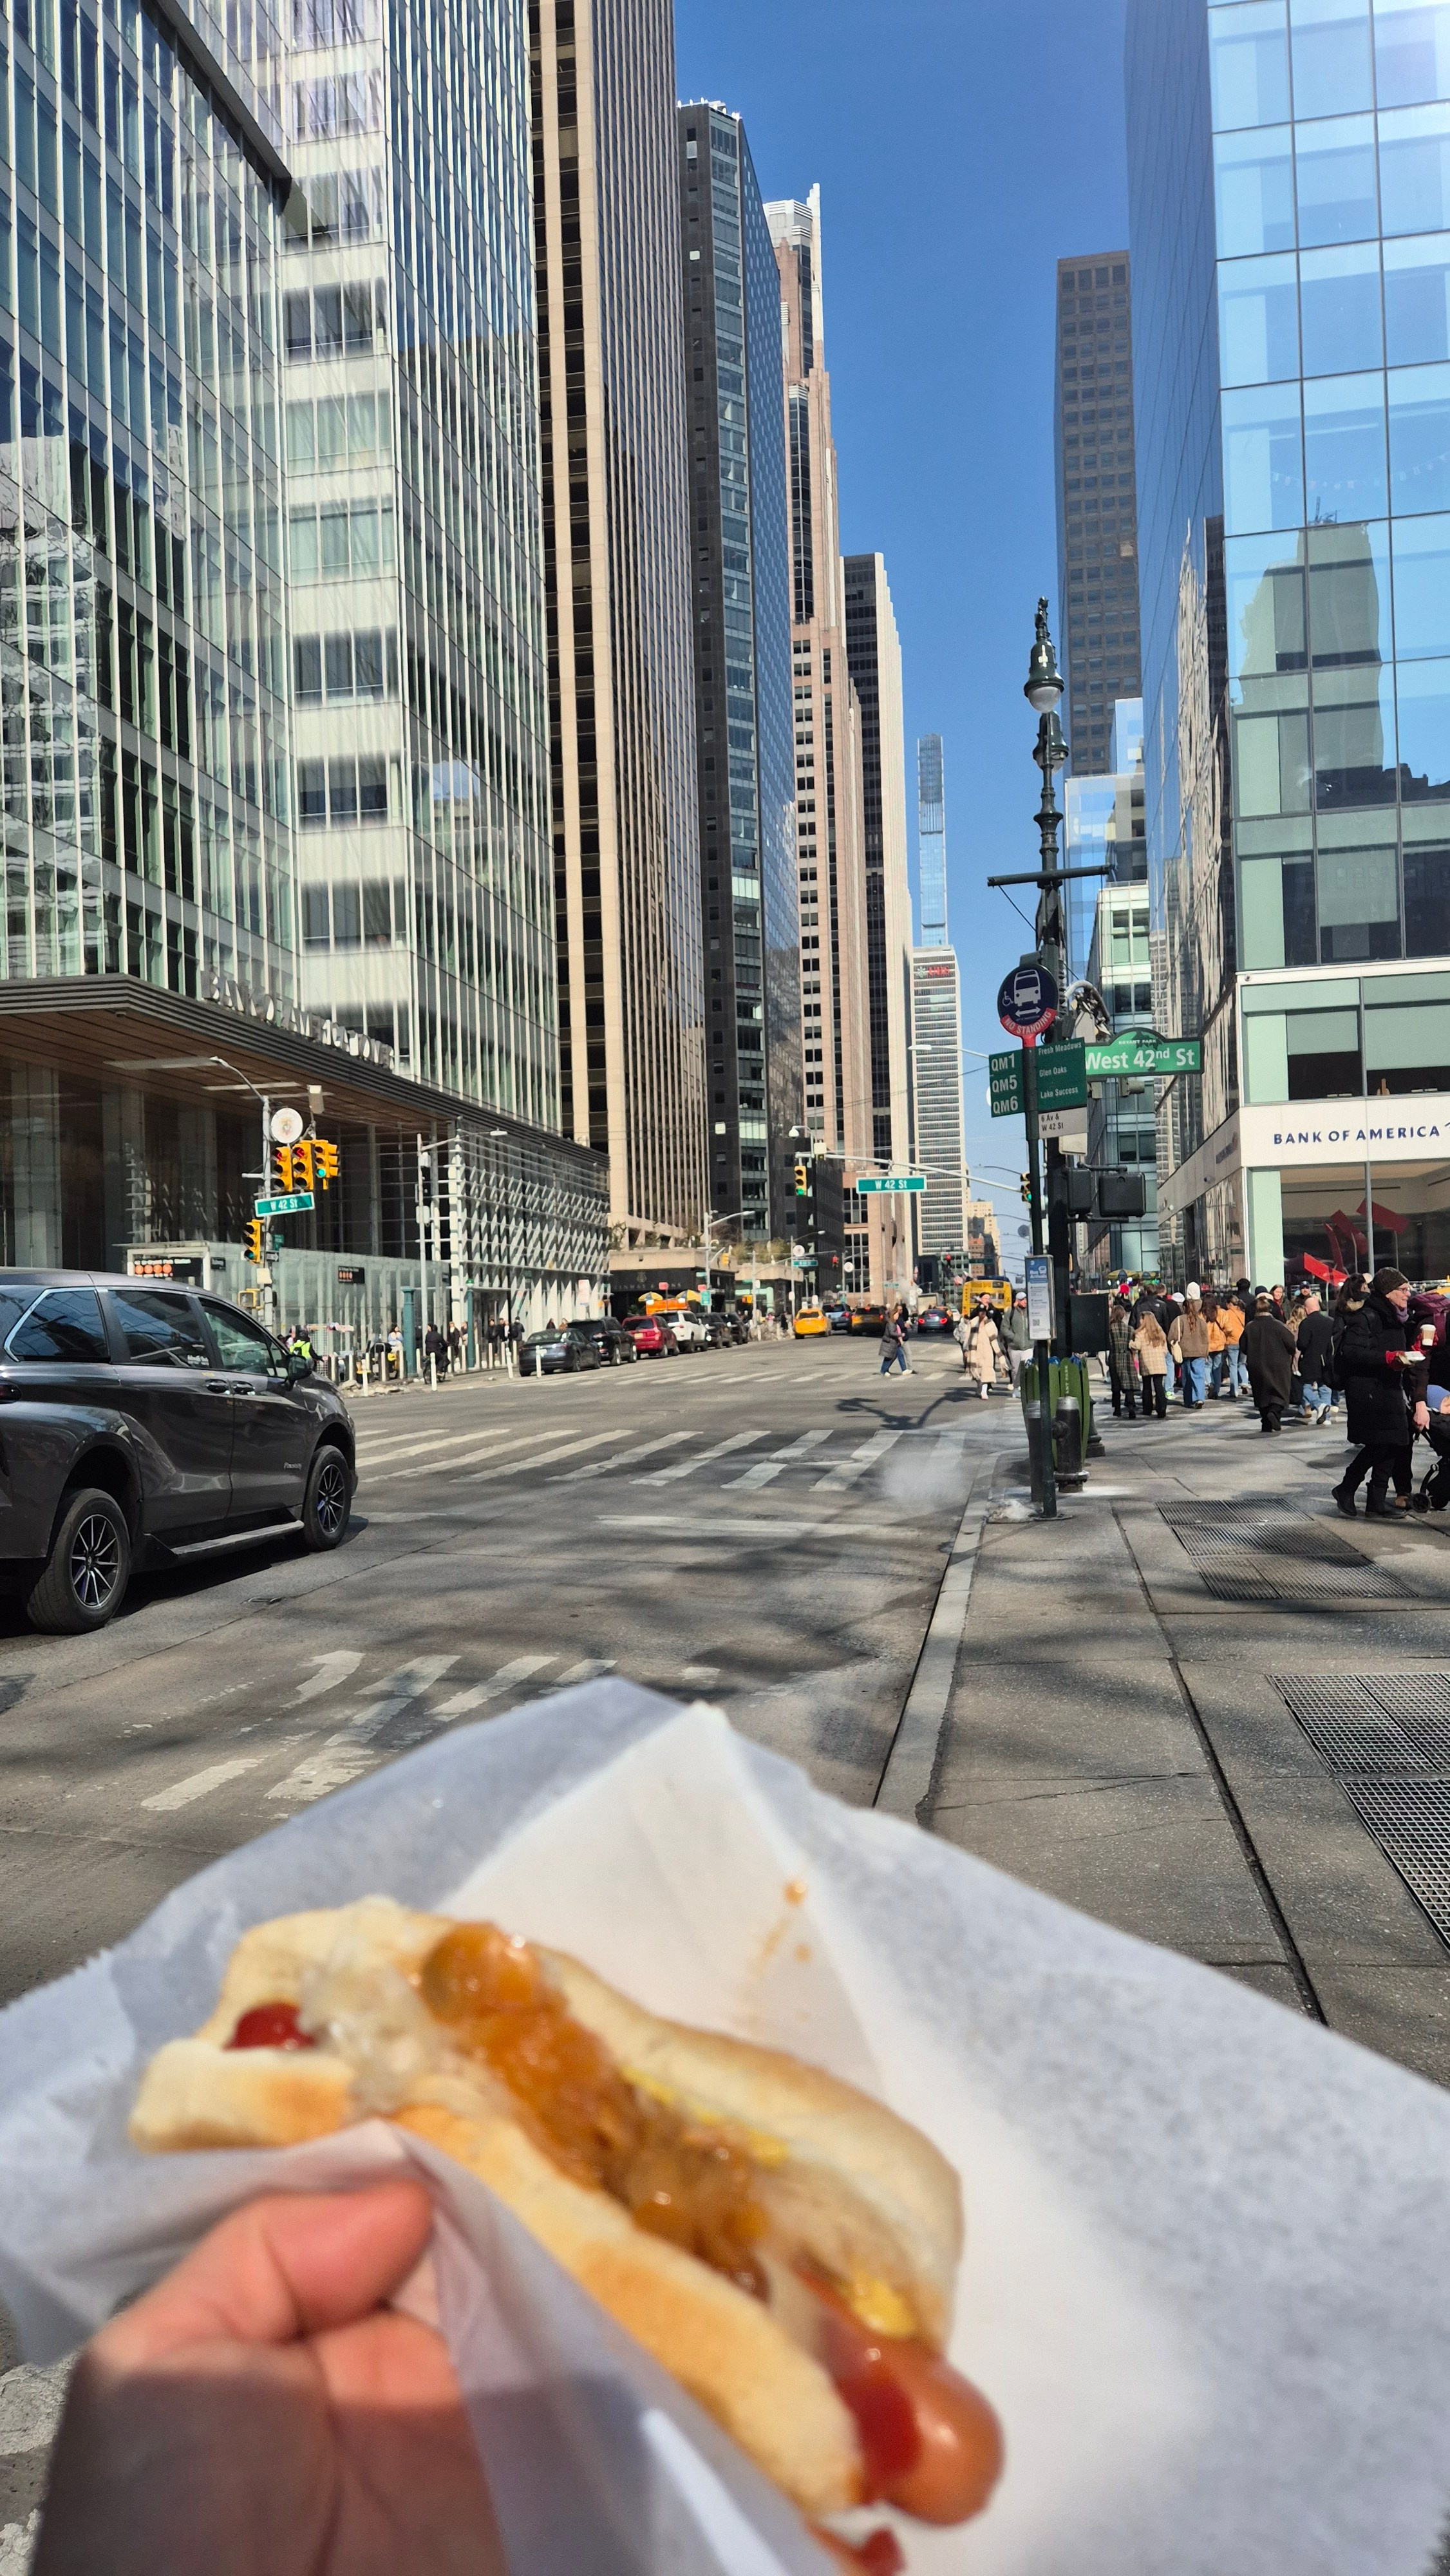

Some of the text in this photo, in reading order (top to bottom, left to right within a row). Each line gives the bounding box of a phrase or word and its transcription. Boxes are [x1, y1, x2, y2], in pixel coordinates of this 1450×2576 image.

[1004, 1010, 1051, 1034] NO STANDING
[1038, 1042, 1082, 1056] Fresh Meadows
[1086, 1047, 1195, 1070] West 42nd St
[992, 1052, 1015, 1072] QM1
[1039, 1066, 1067, 1077] Glen Oaks
[992, 1074, 1017, 1093] QM5
[1040, 1086, 1078, 1099] Lake Success
[993, 1095, 1019, 1114] QM6
[1274, 1126, 1440, 1145] BANK OF AMERICA
[875, 1179, 907, 1189] W 42 St
[270, 1198, 298, 1211] W 42 St
